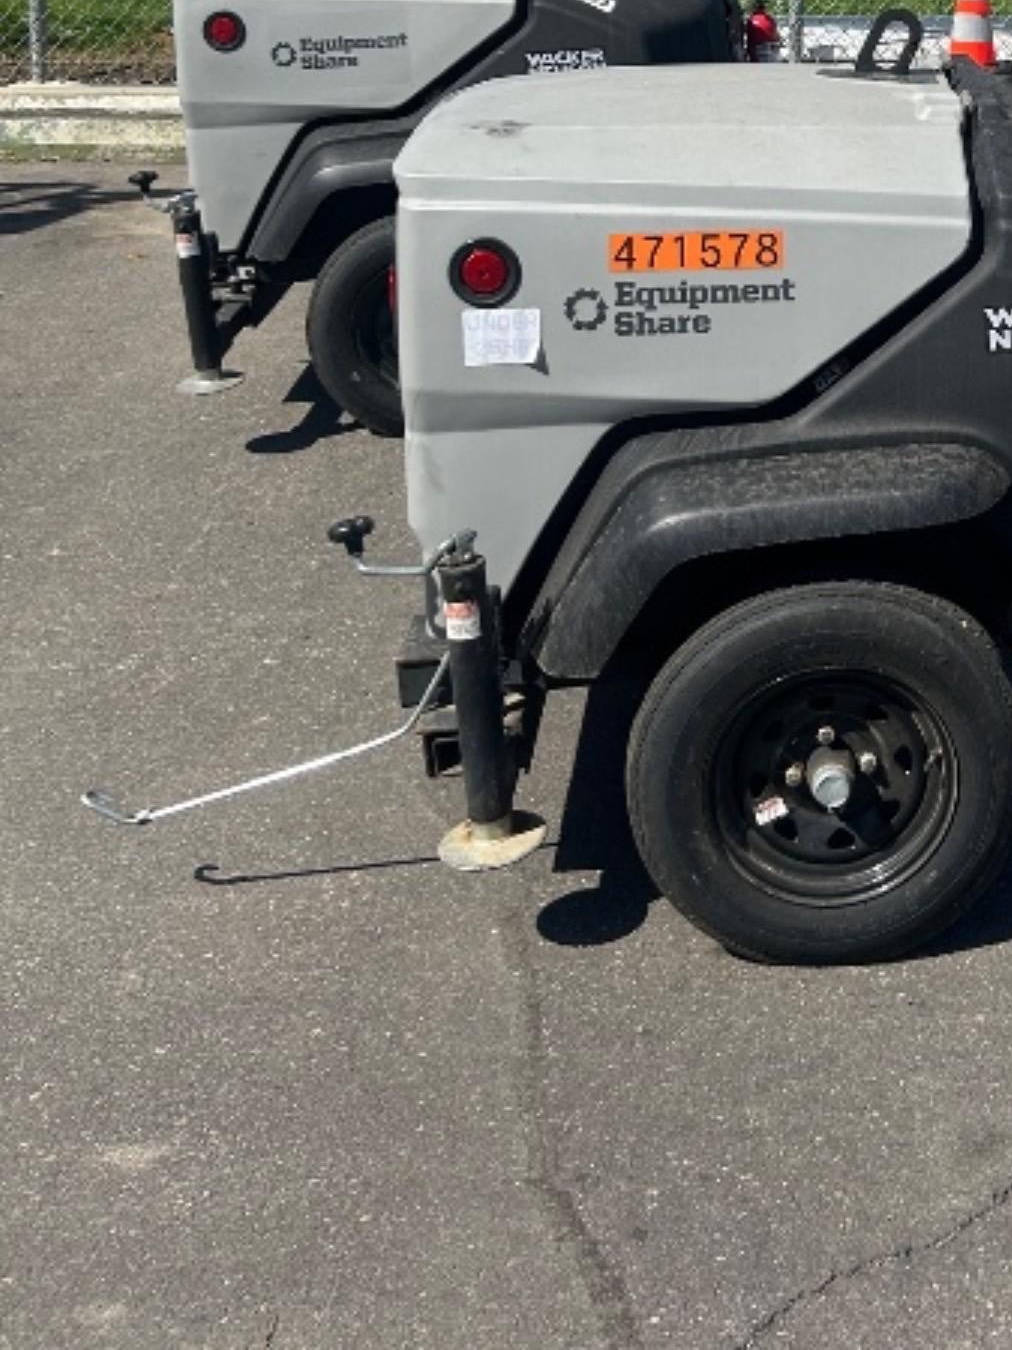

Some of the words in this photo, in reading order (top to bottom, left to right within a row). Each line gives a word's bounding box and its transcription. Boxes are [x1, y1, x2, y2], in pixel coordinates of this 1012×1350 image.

[613, 233, 778, 270] 471578
[614, 278, 796, 311] Equipment
[614, 311, 712, 337] Share
